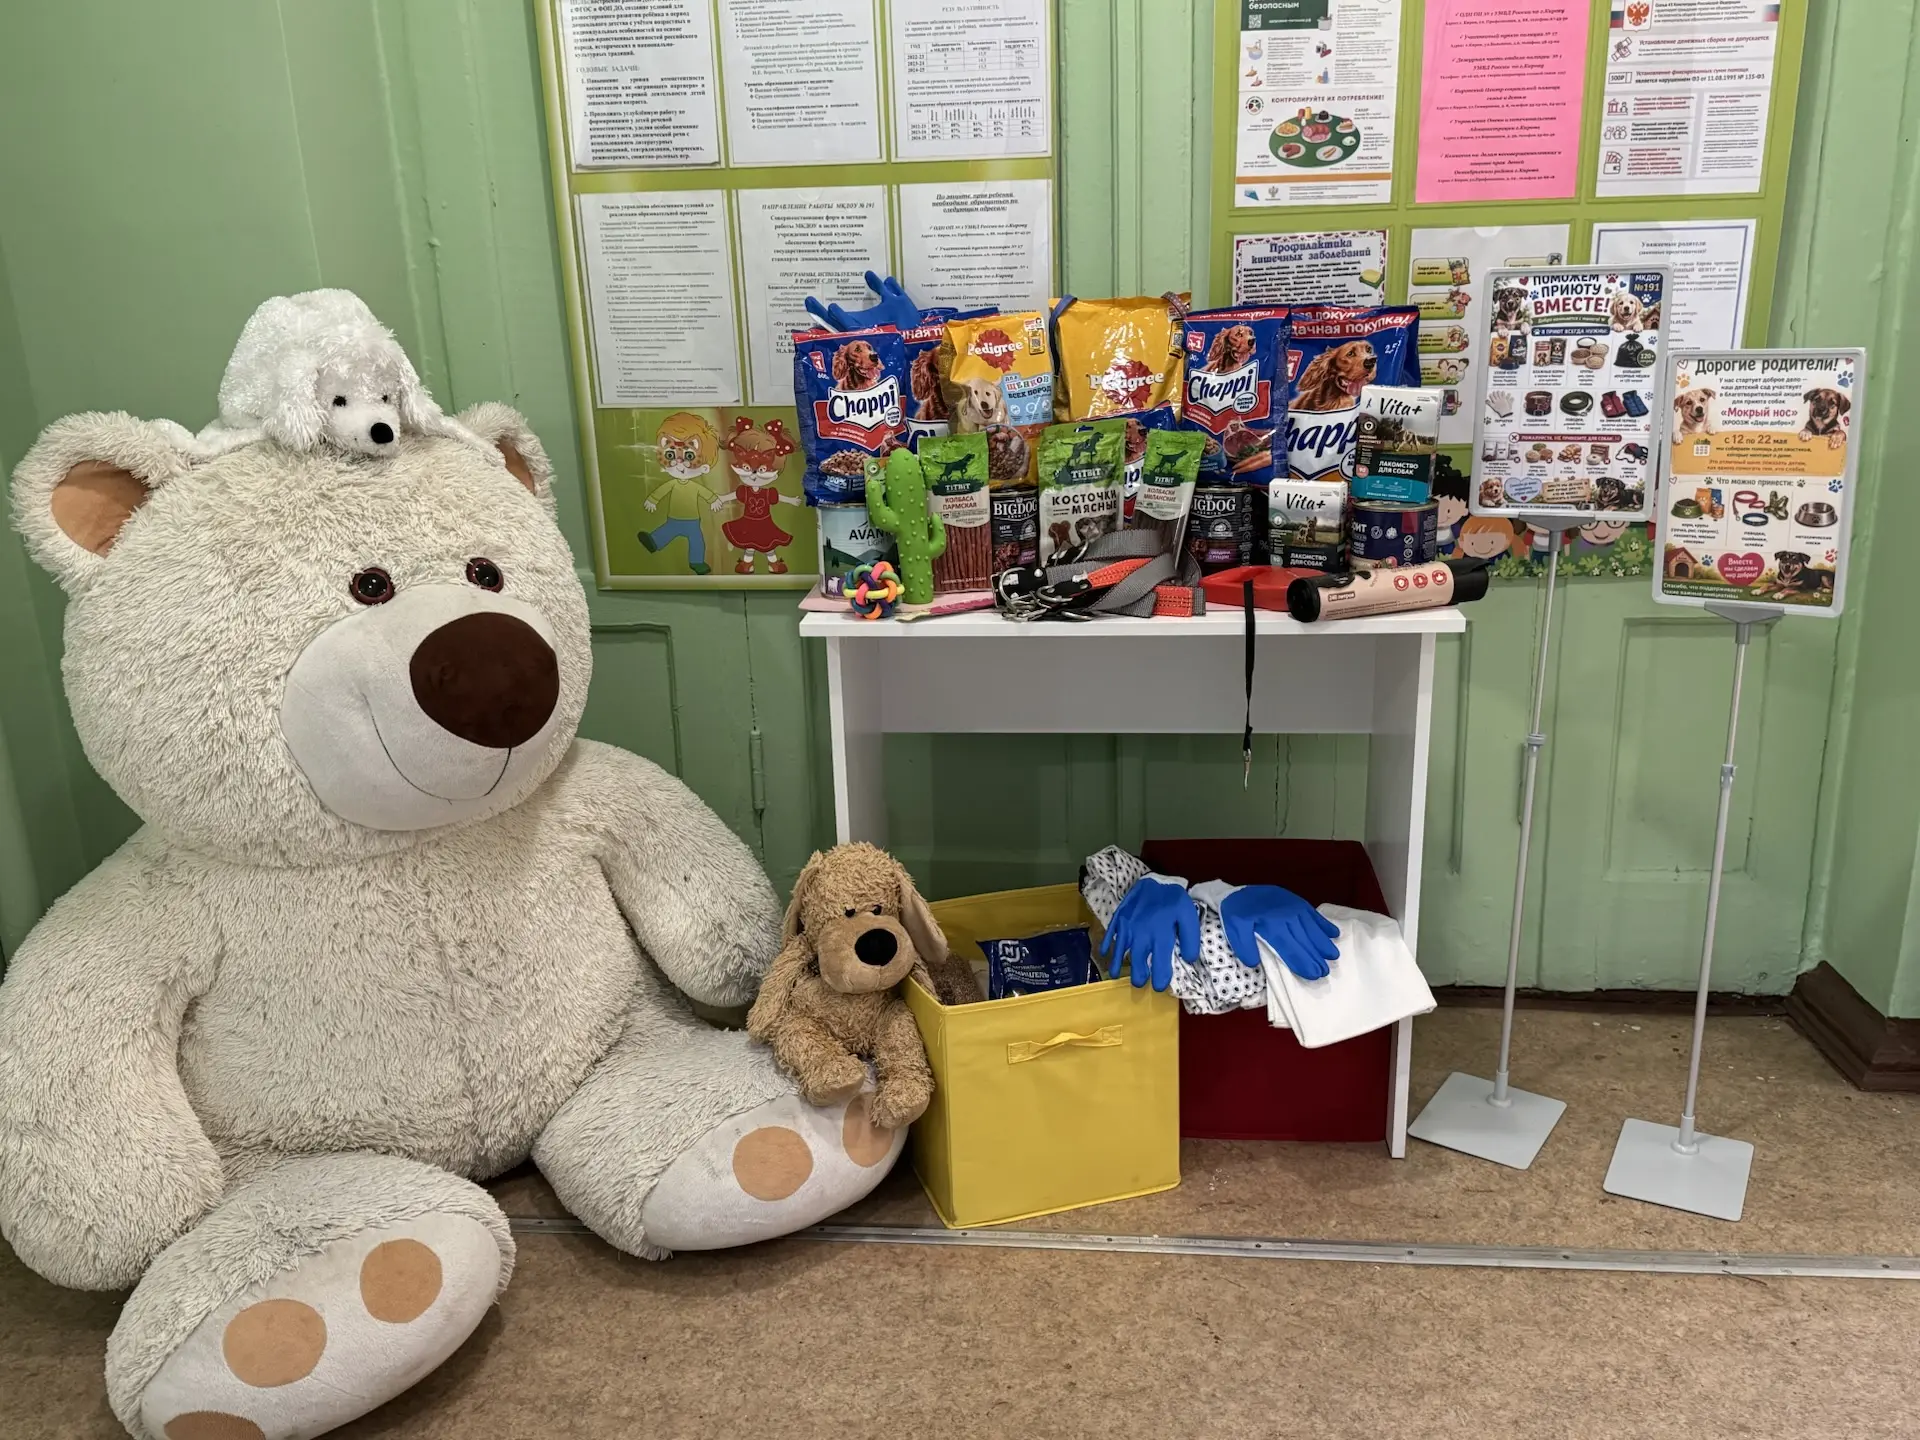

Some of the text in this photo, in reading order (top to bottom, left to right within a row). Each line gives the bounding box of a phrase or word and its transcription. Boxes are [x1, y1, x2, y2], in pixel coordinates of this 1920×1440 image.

[1270, 239, 1352, 253] Профилактика
[1252, 248, 1371, 264] кишечных заболеваний
[1541, 284, 1601, 297] ПРИЮТУ
[1634, 283, 1660, 292] №191
[1534, 298, 1609, 315] ВМЕСТЕ!
[1345, 315, 1410, 335] покупка!
[967, 342, 1024, 357] Pedigree
[1695, 358, 1839, 375] Дорогие родители!
[1006, 375, 1049, 390] ЩЕНКОВ
[1188, 370, 1253, 403] Chappi
[1028, 386, 1052, 396] ПОРОД
[828, 384, 896, 422] Chappi
[1380, 397, 1422, 416] Vita+
[1721, 407, 1798, 419] «Мокрый нос»
[1732, 435, 1744, 444] 12
[1758, 435, 1771, 444] 22
[1379, 461, 1418, 469] ЛАКОМСТВО
[1052, 489, 1117, 506] КОСТОЧКИ
[1191, 498, 1236, 512] IGDOG
[1286, 493, 1326, 511] Vita+
[1072, 500, 1116, 515] МЯСНЫЕ
[849, 530, 891, 540] AVAN
[1290, 553, 1327, 561] ЛАКОМСТВО
[1728, 557, 1754, 565] Вместе
